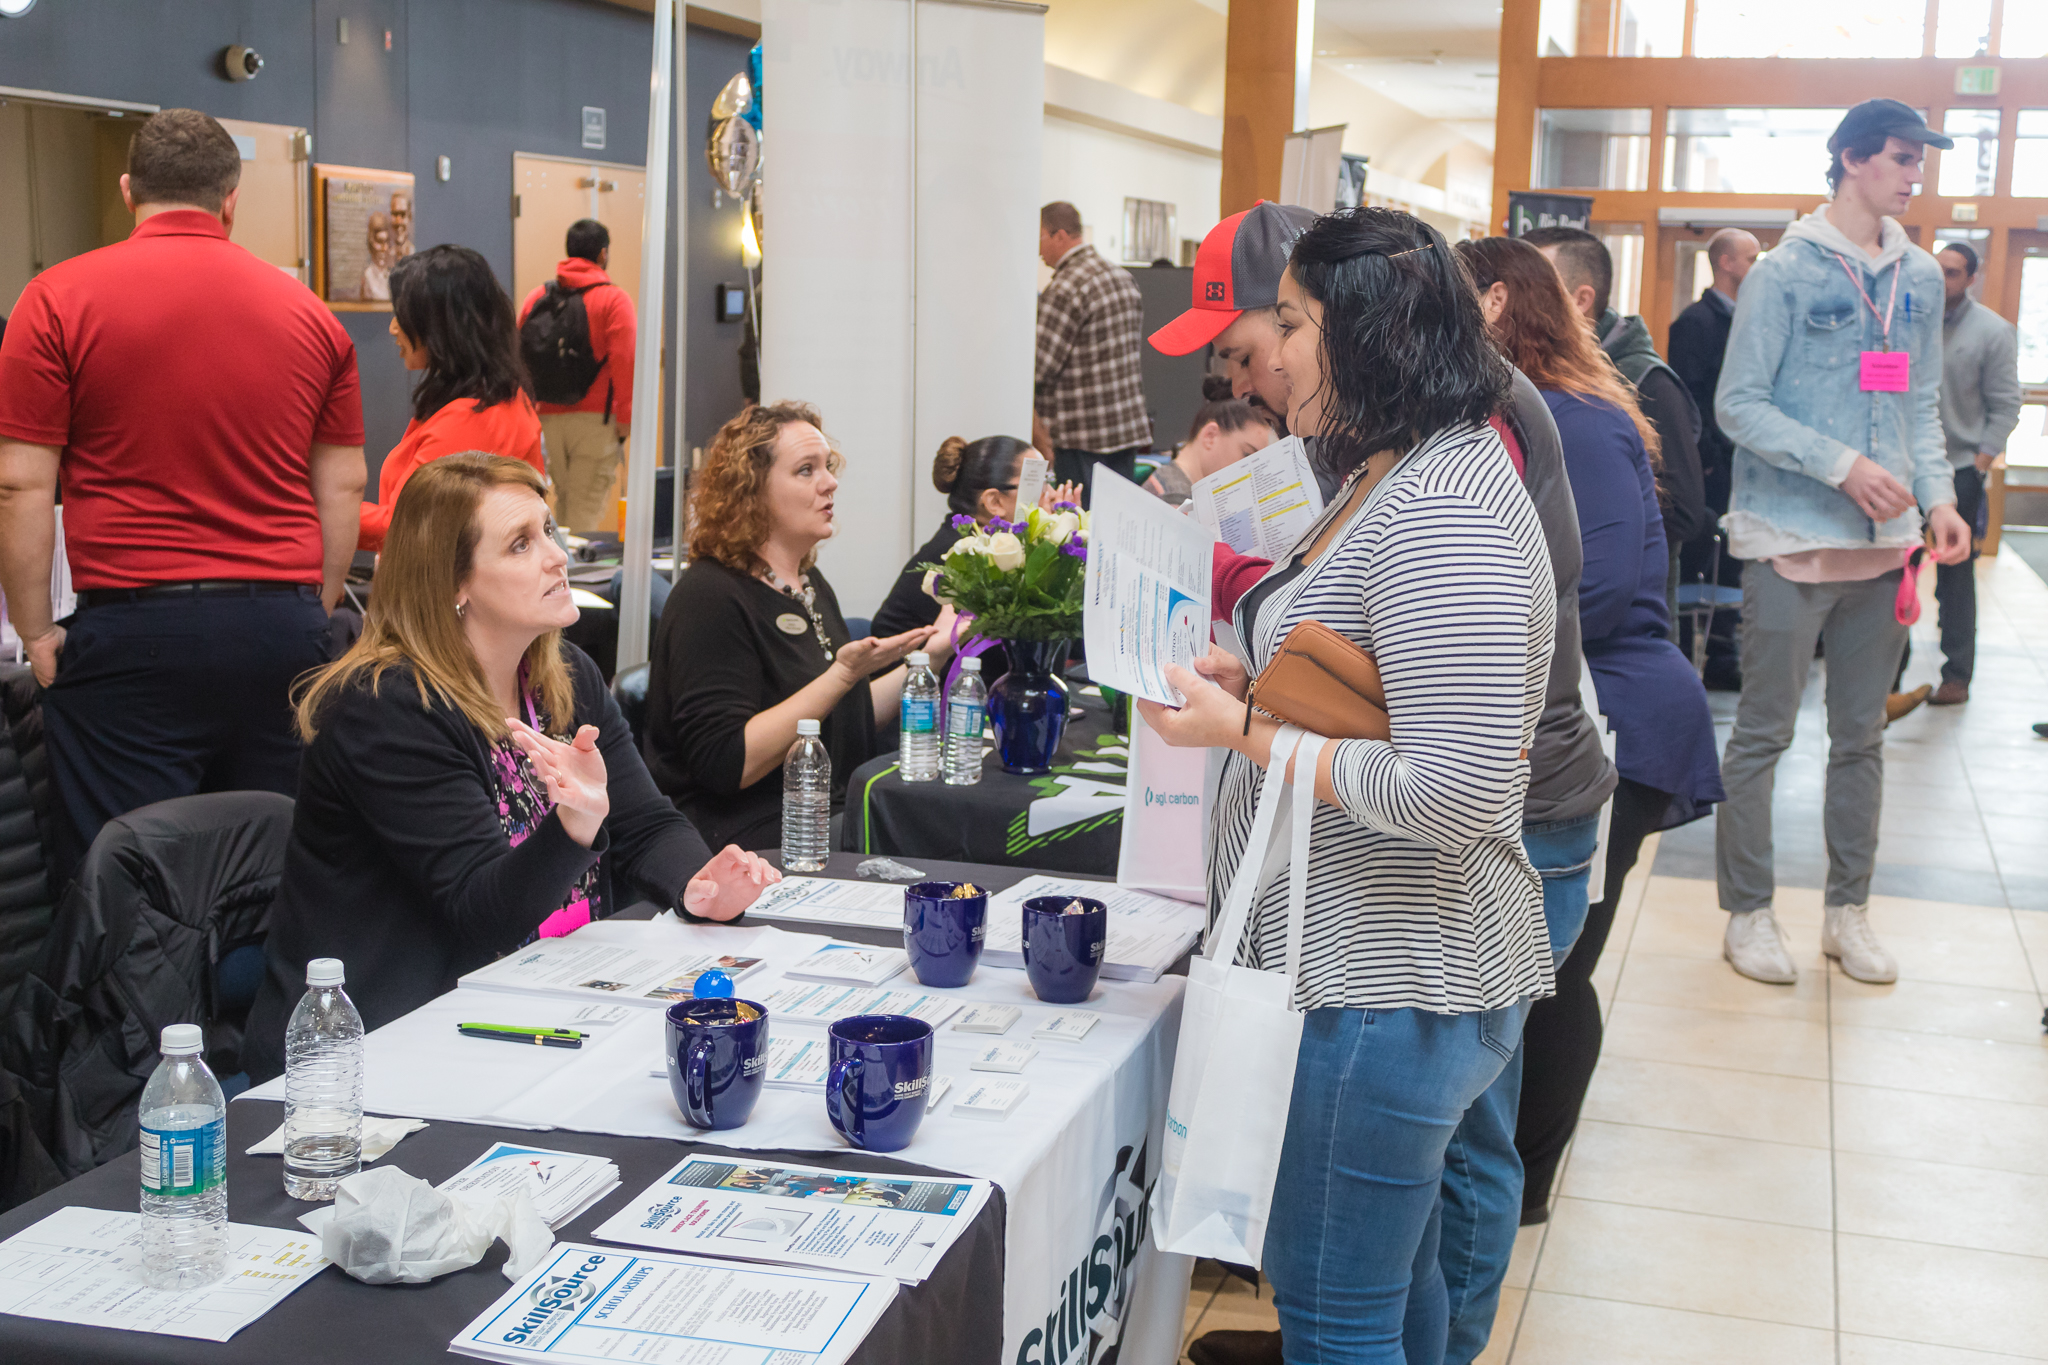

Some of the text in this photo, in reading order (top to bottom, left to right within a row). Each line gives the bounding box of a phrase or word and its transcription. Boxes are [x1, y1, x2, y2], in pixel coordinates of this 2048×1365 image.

[1155, 791, 1200, 806] sgl carbon
[459, 1166, 501, 1192] ORIENTATION
[640, 1196, 682, 1230] SkillSource
[687, 1208, 710, 1225] SOLUTIONS
[502, 1254, 606, 1344] SkillSource
[594, 1266, 654, 1320] SCHOLARSHIPS
